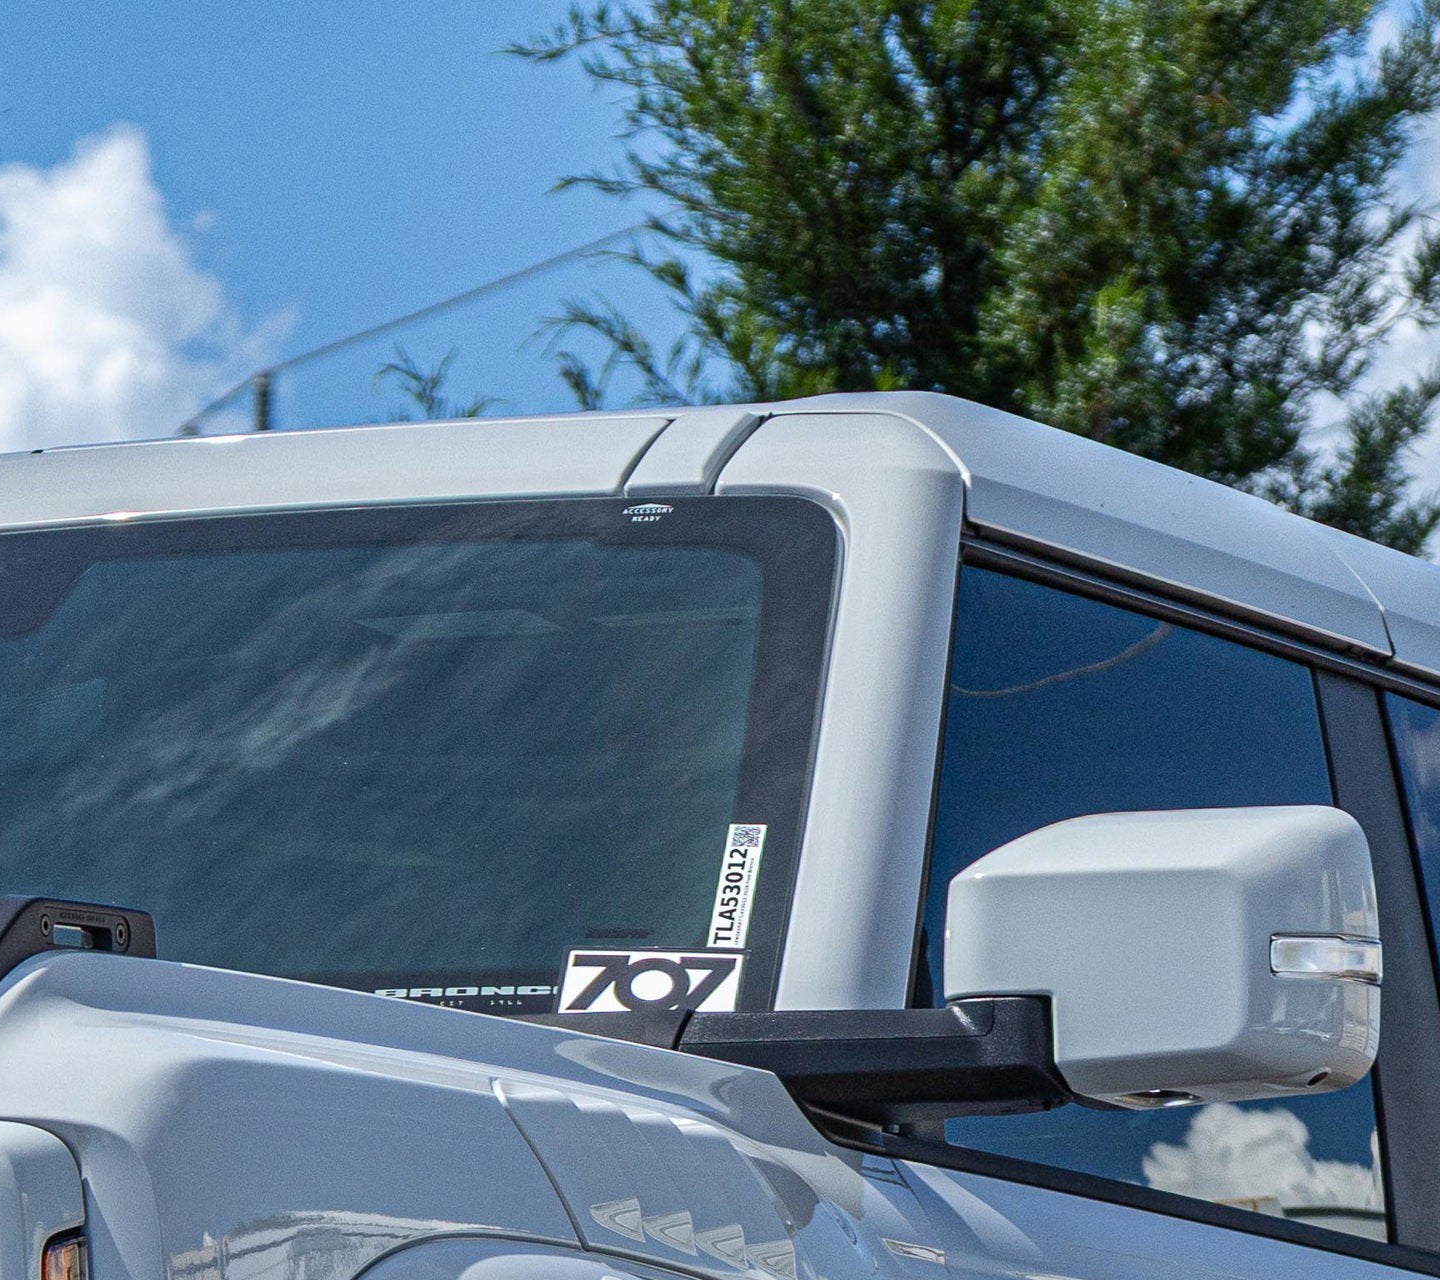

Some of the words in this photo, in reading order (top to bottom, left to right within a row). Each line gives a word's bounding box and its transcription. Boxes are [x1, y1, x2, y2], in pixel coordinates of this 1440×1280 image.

[713, 848, 748, 945] TLA53012
[374, 984, 559, 998] BRONC
[565, 954, 737, 1012] 707
